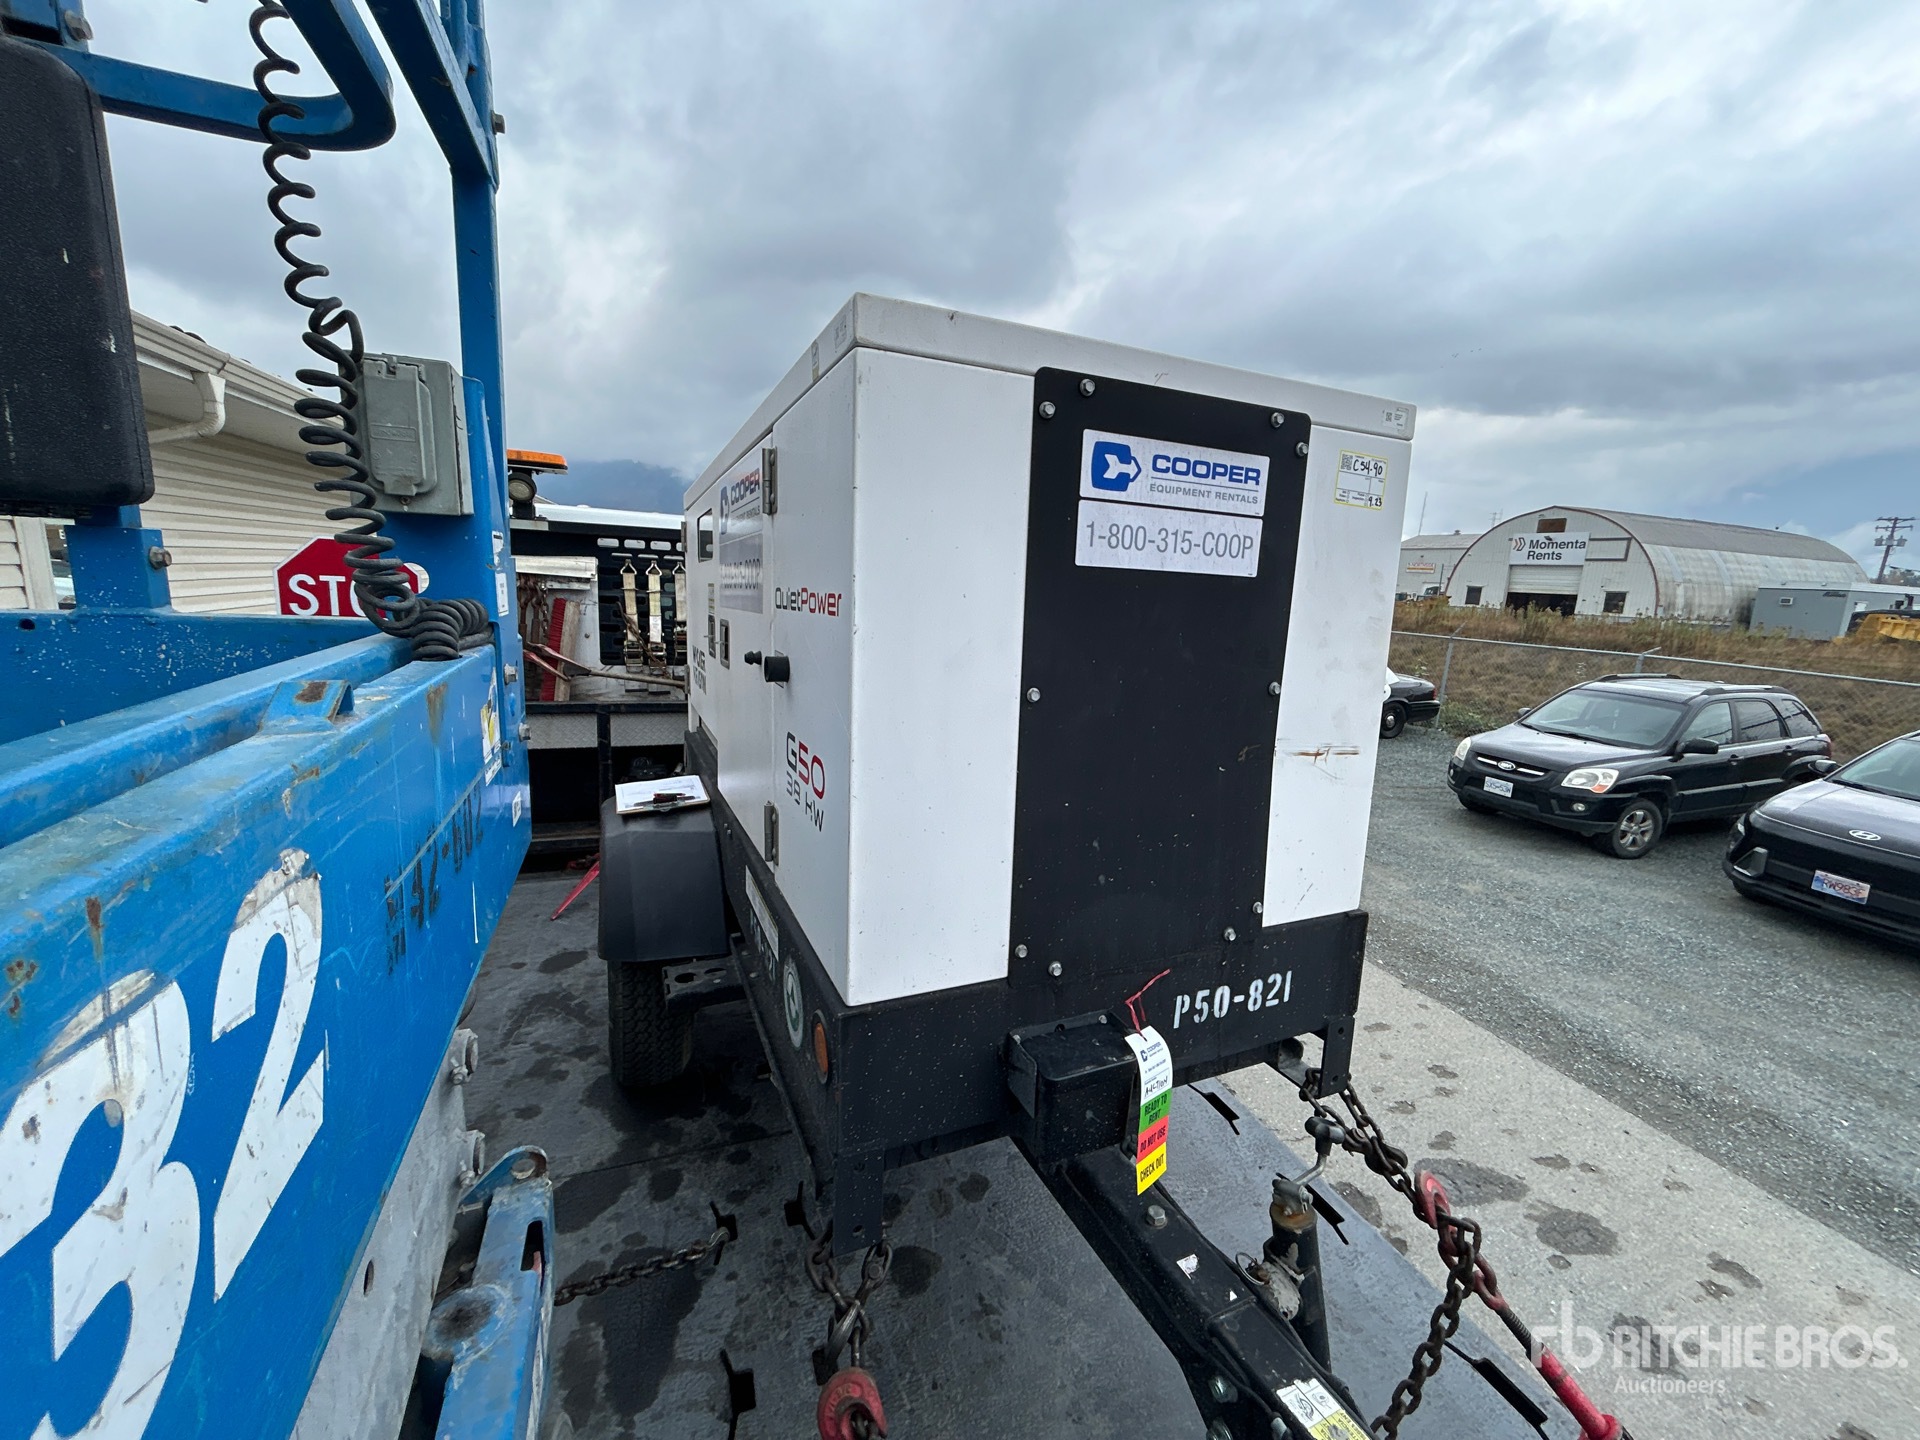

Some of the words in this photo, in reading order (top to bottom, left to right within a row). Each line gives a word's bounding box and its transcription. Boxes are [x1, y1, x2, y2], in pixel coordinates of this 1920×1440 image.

[1152, 454, 1261, 486] COOPER
[731, 468, 760, 505] COOPER
[1150, 483, 1211, 499] EQUIPMENT
[1215, 491, 1258, 505] RENTALS
[1086, 521, 1253, 559] 1-800-315-COOP
[1528, 539, 1587, 550] Momenta
[1527, 550, 1563, 561] Rents
[775, 587, 842, 617] QuietPower
[786, 731, 825, 800] G50
[1173, 970, 1293, 1029] P50-821
[1144, 1097, 1161, 1116] READY
[1161, 1093, 1168, 1106] TO
[1148, 1109, 1161, 1125] RENT
[1140, 1140, 1147, 1153] DO
[1147, 1132, 1157, 1147] NOT
[1157, 1125, 1166, 1140] USE
[1140, 1160, 1156, 1183] CHECK
[1155, 1153, 1165, 1170] OUT
